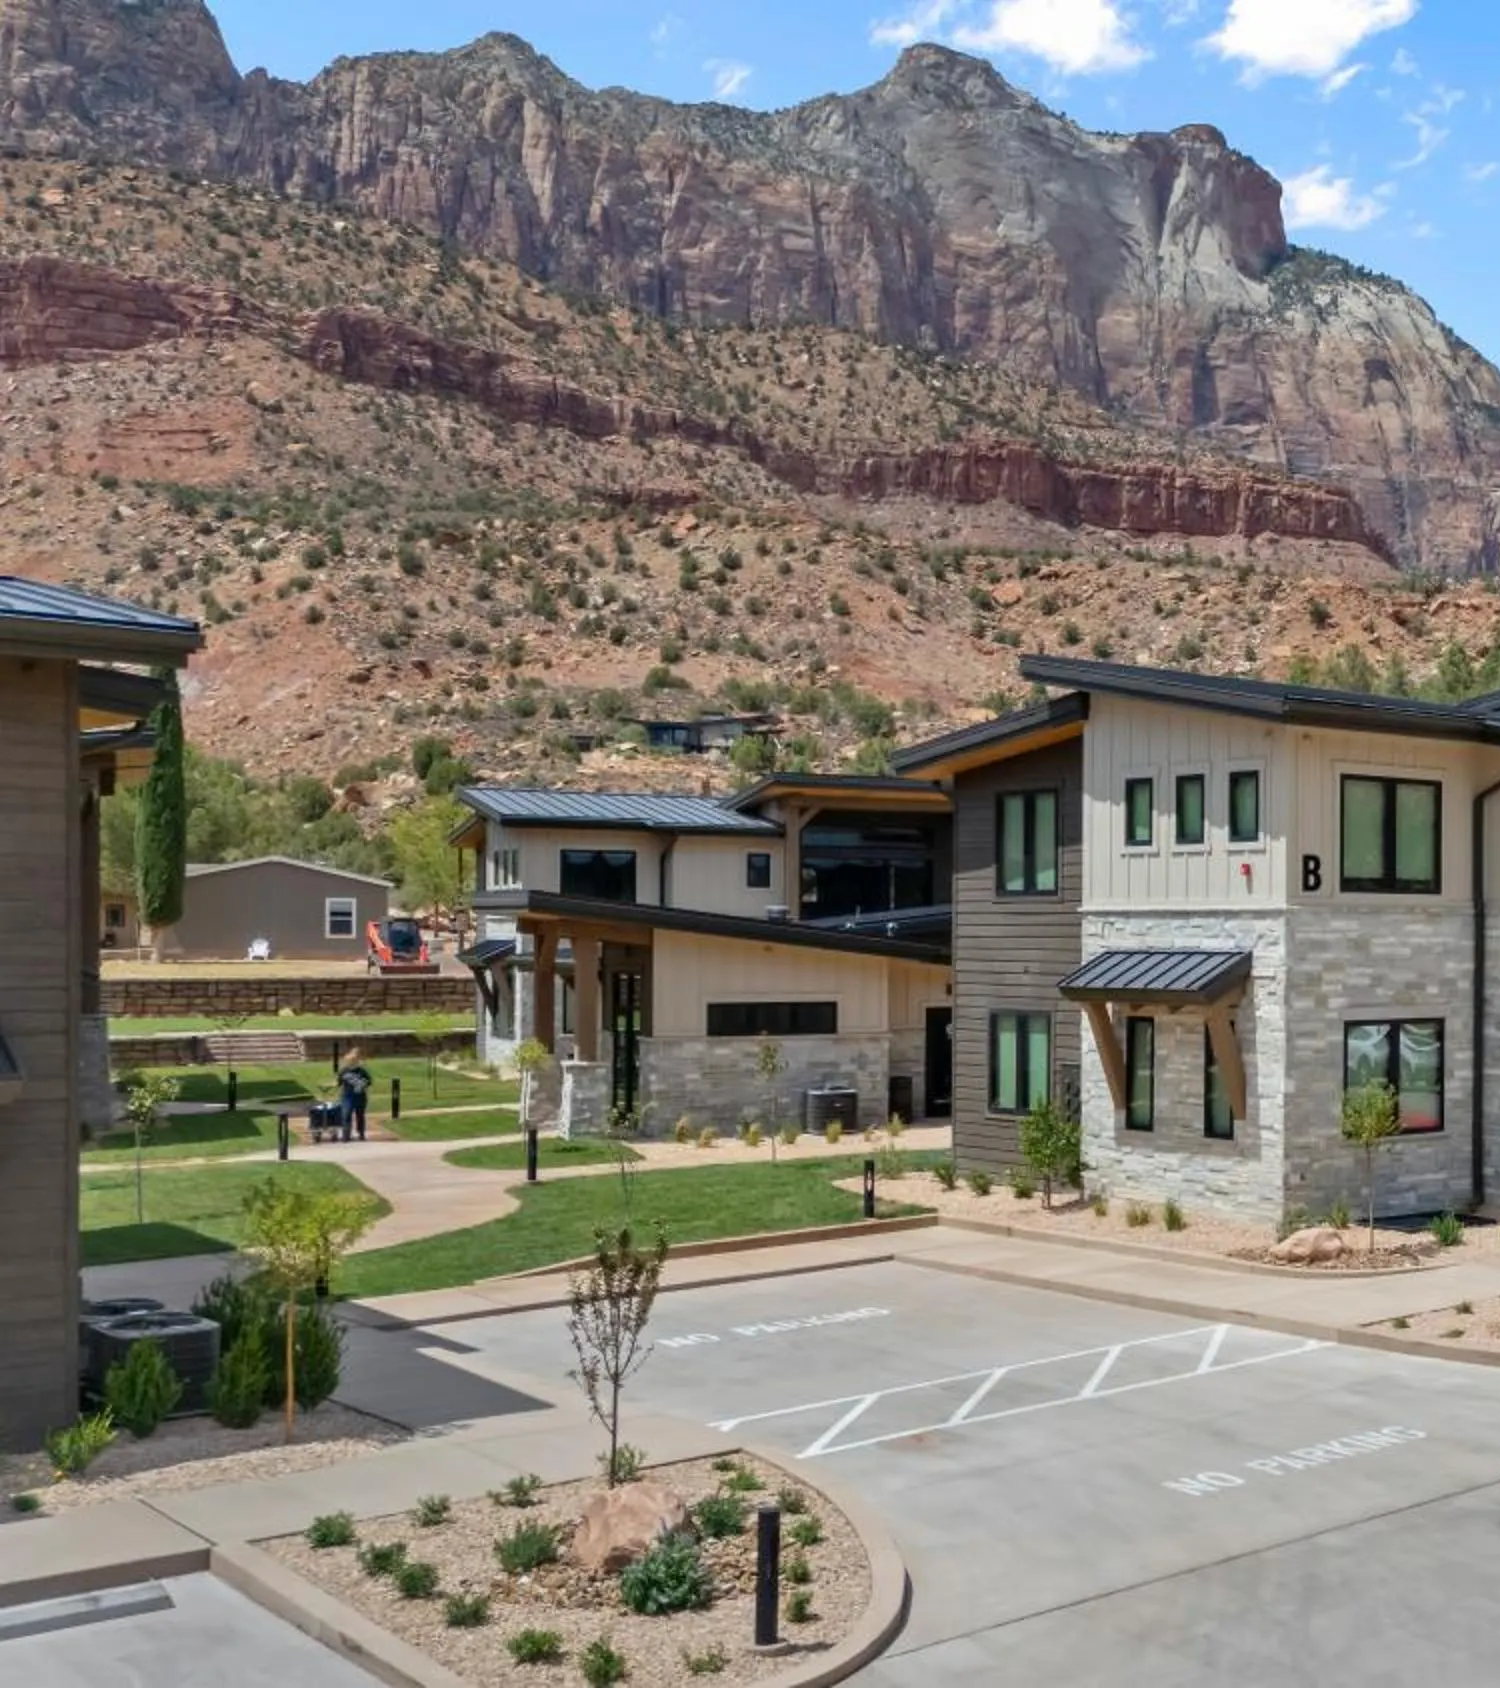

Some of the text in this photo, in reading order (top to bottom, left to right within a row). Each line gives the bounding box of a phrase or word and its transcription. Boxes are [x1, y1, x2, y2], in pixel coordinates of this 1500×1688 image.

[1302, 854, 1322, 892] B
[655, 1307, 891, 1348] NO PARKING
[1161, 1426, 1428, 1496] NO PARKING
